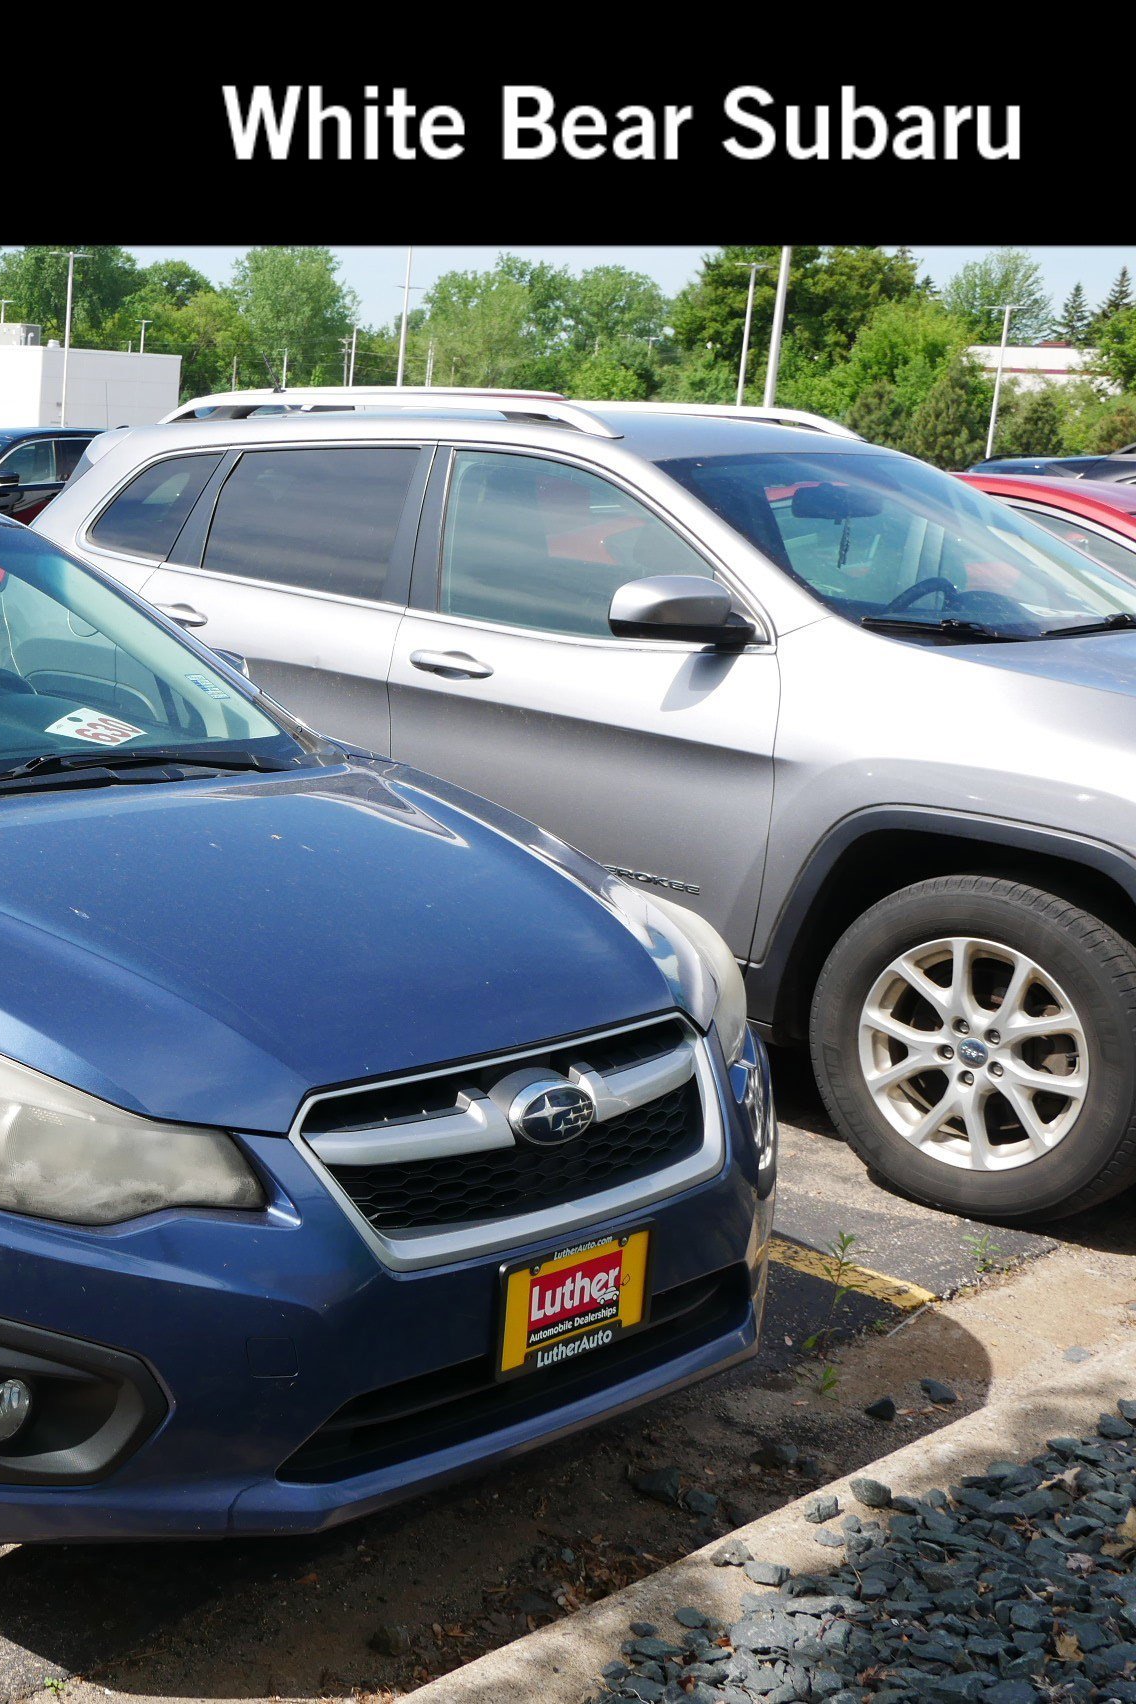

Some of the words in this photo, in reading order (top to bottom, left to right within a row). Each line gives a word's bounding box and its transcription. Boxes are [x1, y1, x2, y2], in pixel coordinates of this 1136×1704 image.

[75, 717, 142, 743] 630
[553, 1235, 613, 1261] LutherAuto.com
[530, 1266, 621, 1322] Luther
[529, 1319, 573, 1344] Automobile
[573, 1305, 618, 1327] Dealerships
[536, 1329, 613, 1368] LutherAuto
